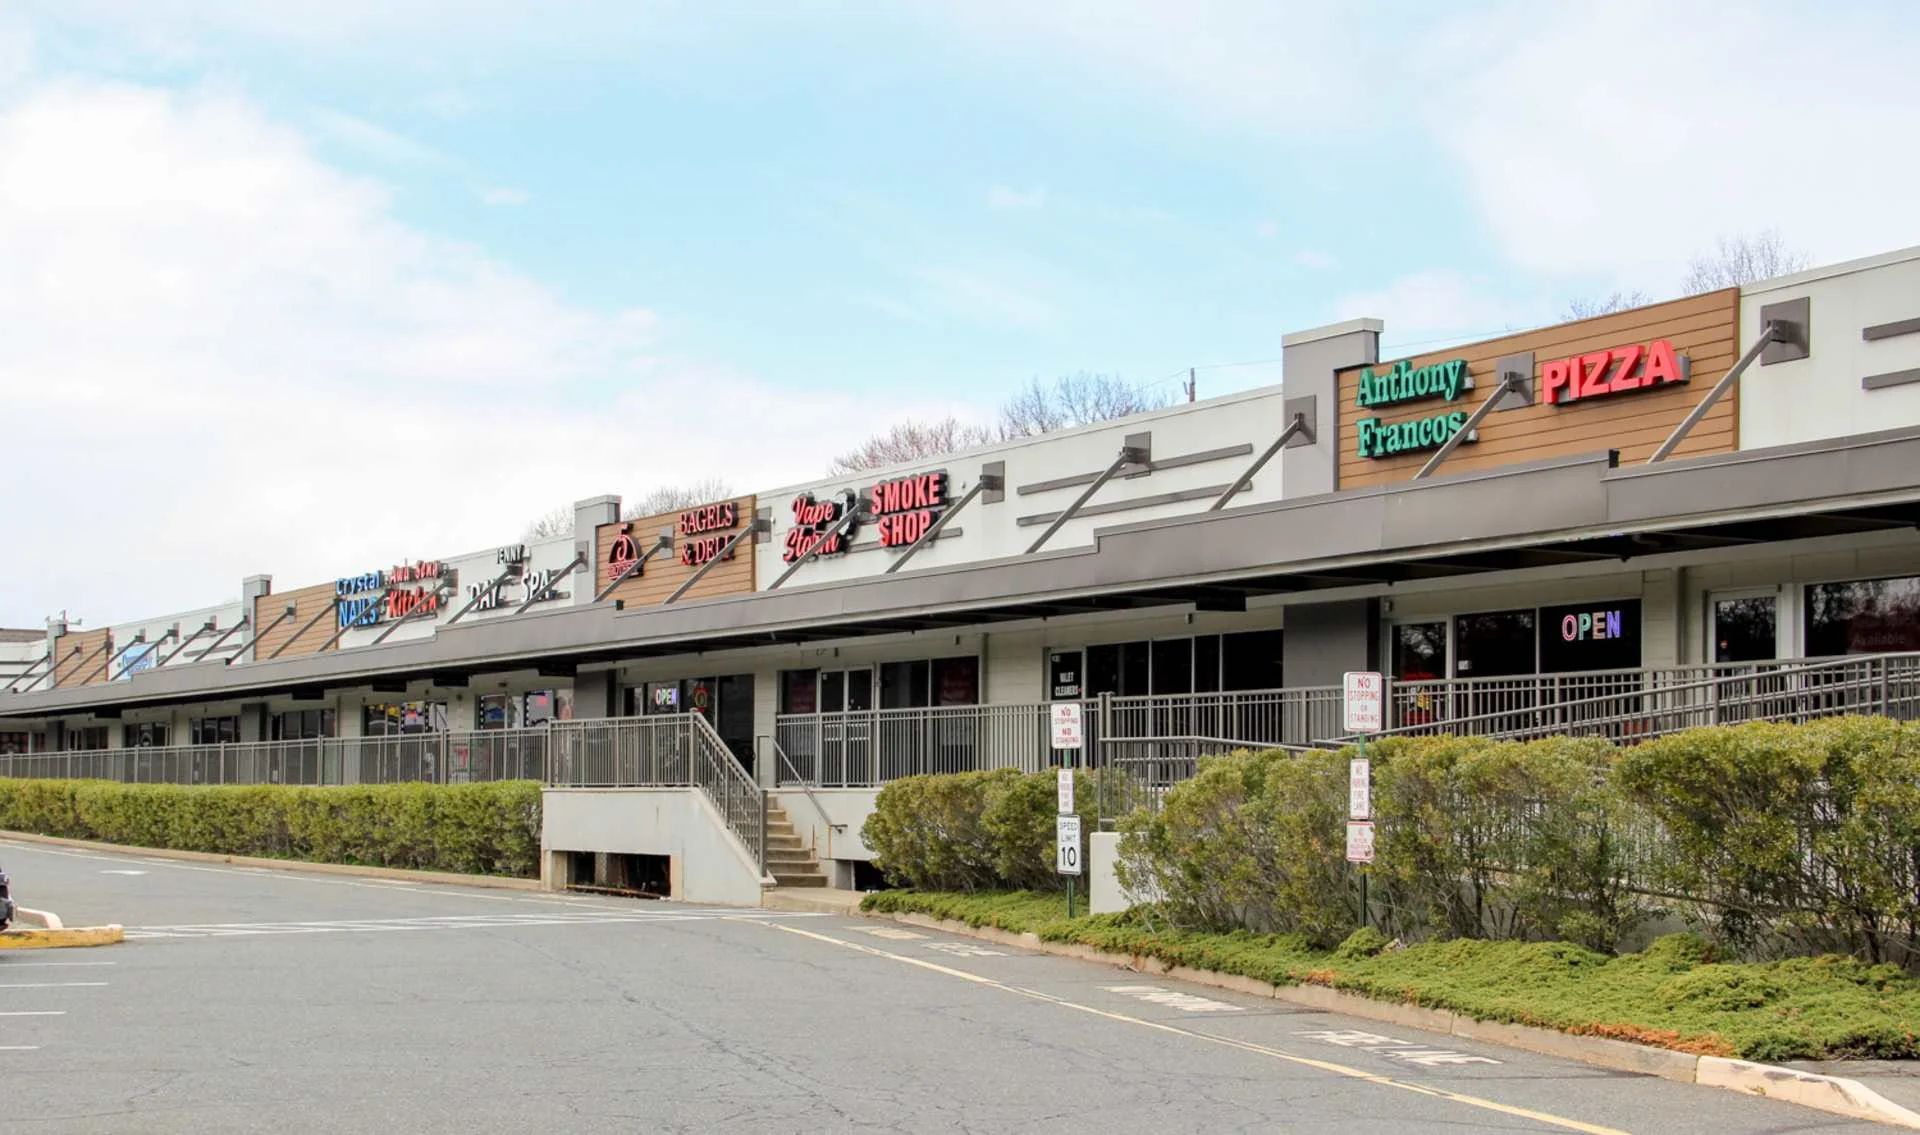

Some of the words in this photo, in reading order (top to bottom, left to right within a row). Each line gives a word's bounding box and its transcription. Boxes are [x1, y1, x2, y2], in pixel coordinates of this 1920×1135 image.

[1356, 359, 1467, 408] Anthony
[1542, 339, 1681, 404] PIZZA
[871, 473, 940, 515] SMOKE
[680, 502, 733, 534] BAGELS
[791, 495, 834, 529] Vape
[879, 510, 932, 547] SHOP
[682, 543, 692, 566] &
[336, 571, 381, 595] Crystal
[521, 569, 551, 602] SPA
[338, 596, 378, 628] NAILS
[1562, 610, 1621, 641] OPEN
[1349, 690, 1378, 701] STOPPING
[1357, 678, 1371, 689] NO
[655, 688, 678, 704] OPEN
[1061, 708, 1072, 717] NO
[1062, 727, 1072, 736] NO
[1059, 821, 1077, 831] SPEED
[1061, 833, 1076, 842] LIMIT
[1061, 846, 1077, 866] 10
